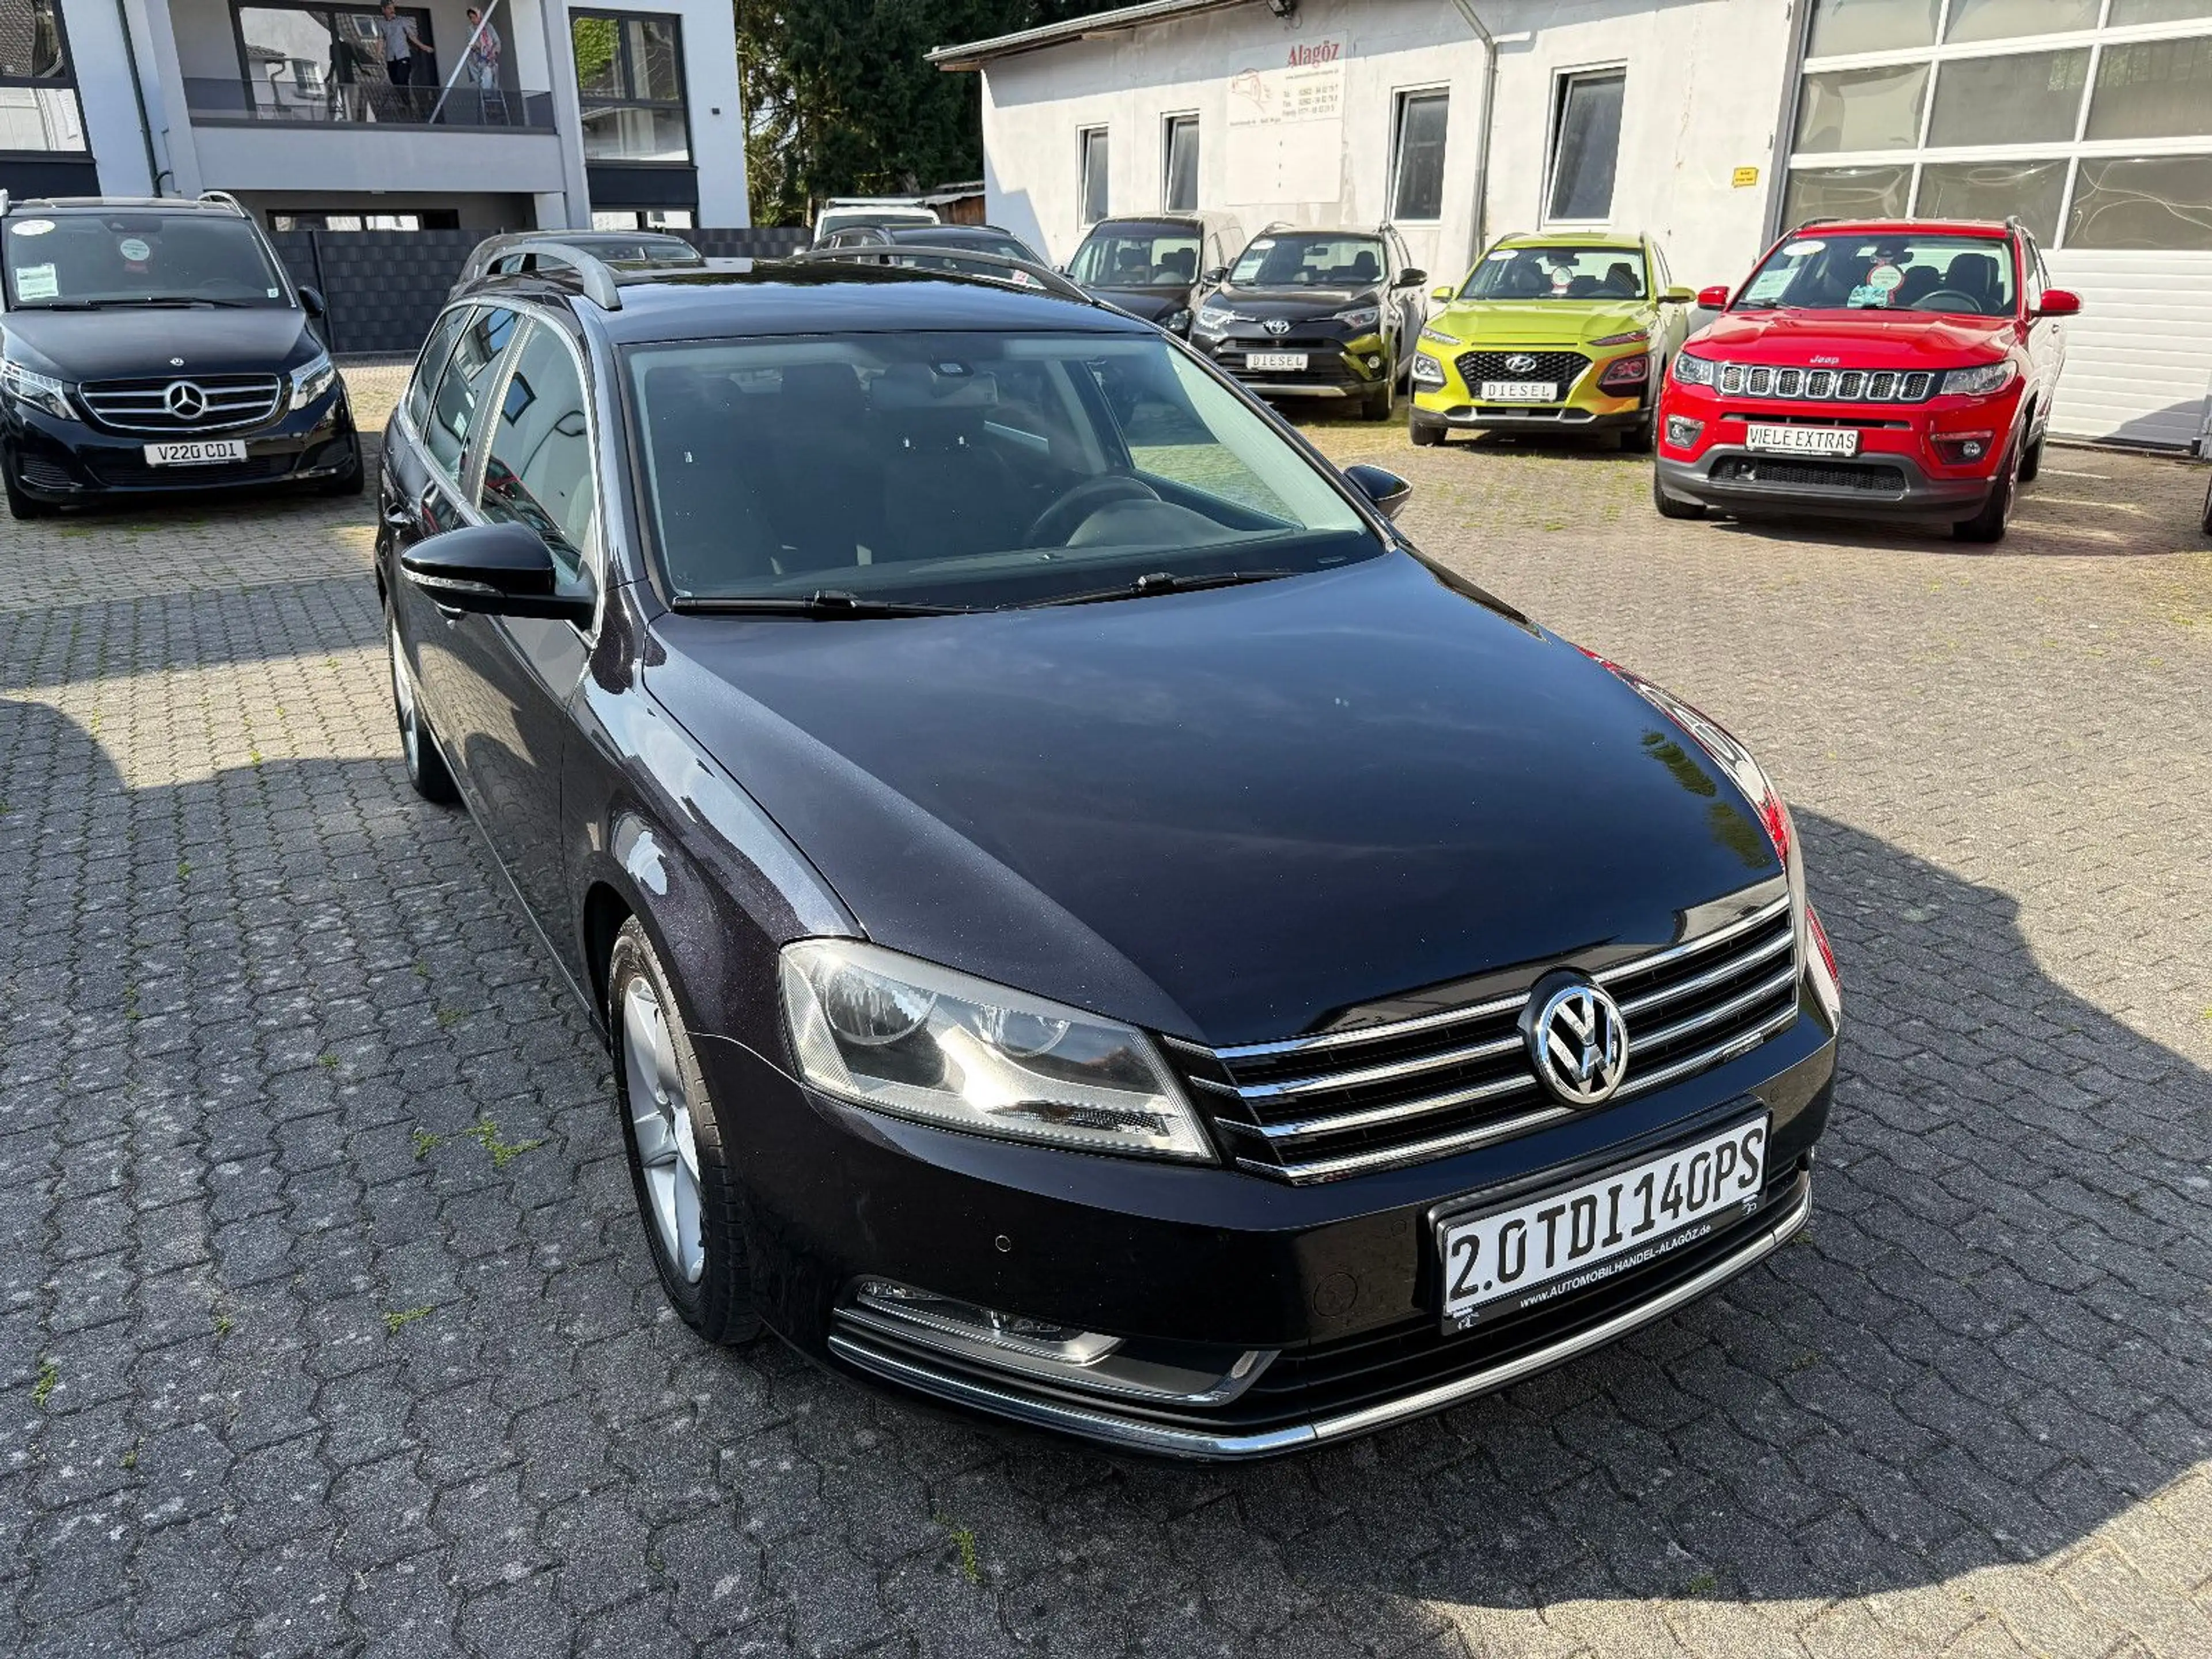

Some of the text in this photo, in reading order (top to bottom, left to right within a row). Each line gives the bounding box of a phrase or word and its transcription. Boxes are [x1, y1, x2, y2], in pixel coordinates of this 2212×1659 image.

[1287, 40, 1340, 68] Alagöz
[1253, 355, 1303, 366] DIESEL
[1809, 354, 1839, 365] Jeep
[1488, 384, 1550, 396] DIESEL
[1750, 428, 1855, 449] VIELE EXTRAS
[157, 442, 237, 460] V220 CDI
[1520, 1225, 1711, 1308] www.AUTOMOBILHANDEL-ALAGÖZ.de
